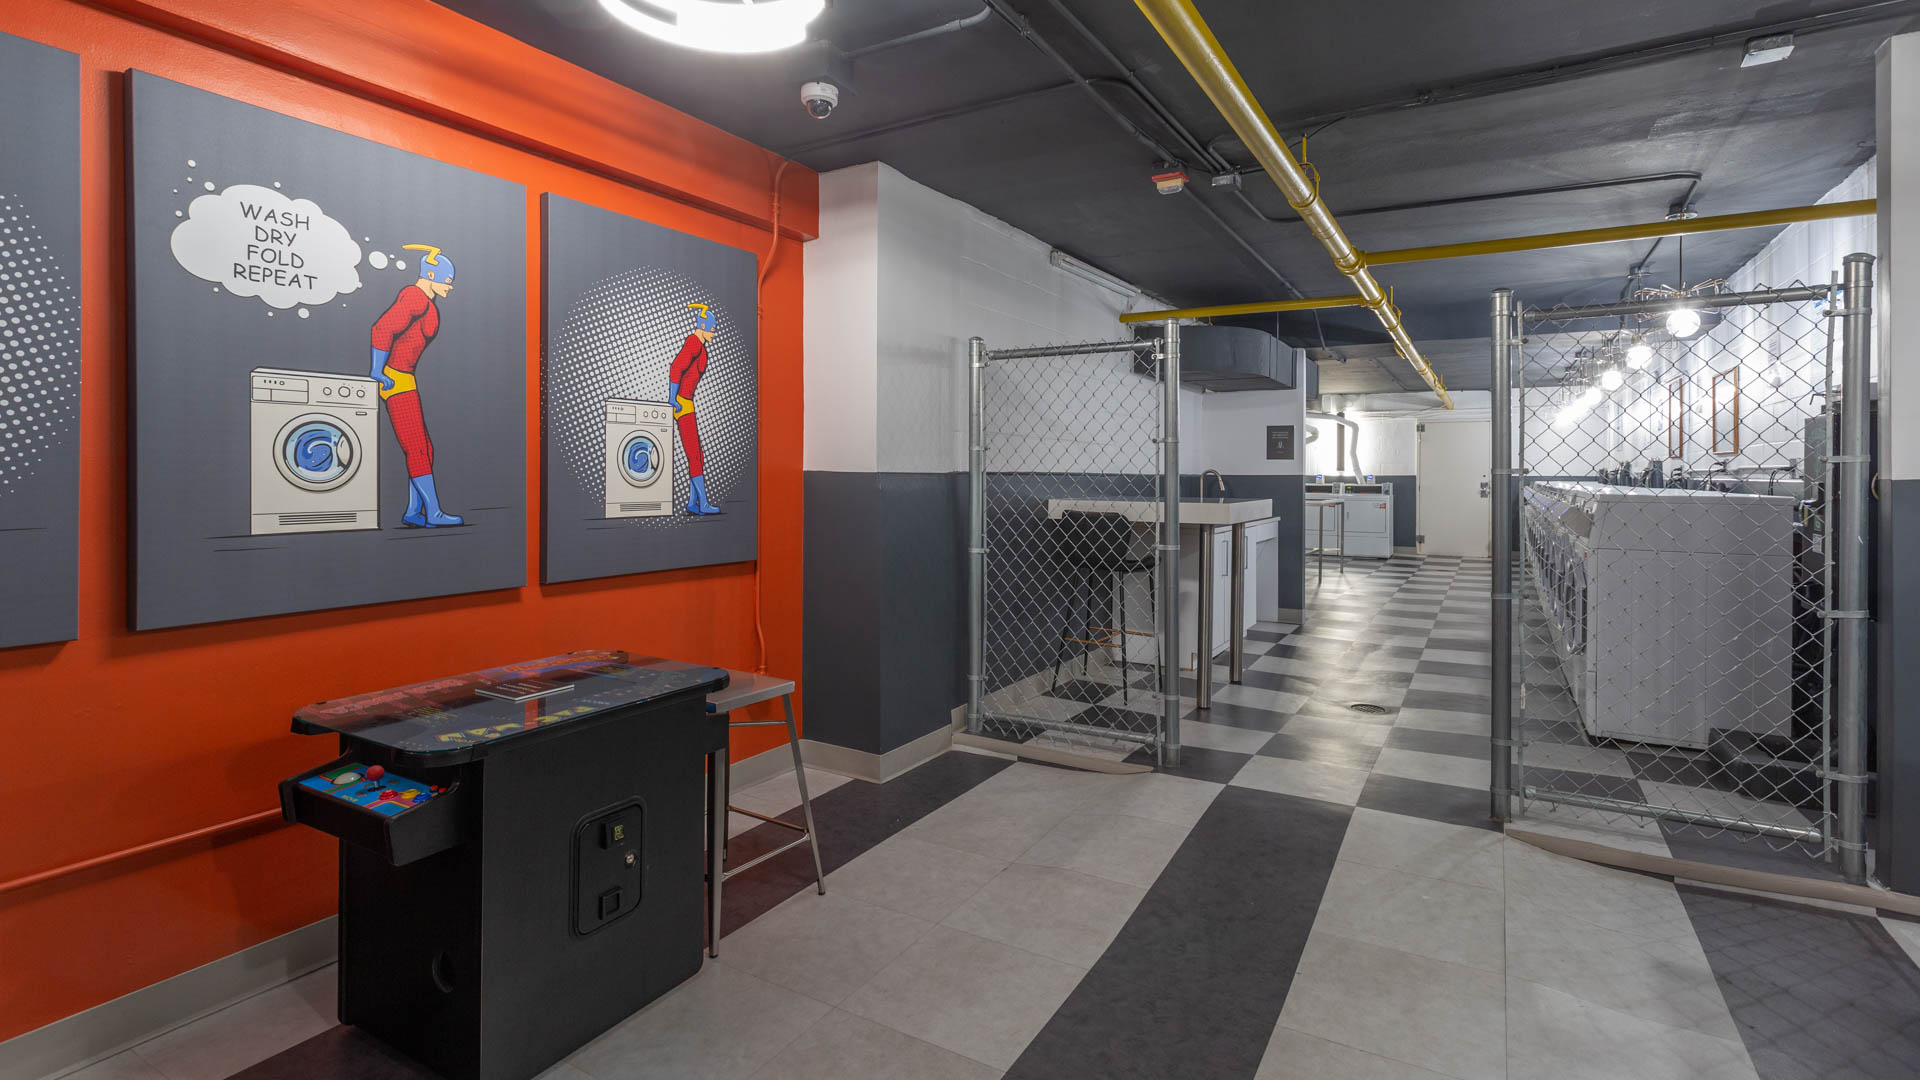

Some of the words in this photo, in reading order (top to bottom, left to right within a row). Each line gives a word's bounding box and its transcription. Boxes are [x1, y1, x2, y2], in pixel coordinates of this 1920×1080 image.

[240, 201, 310, 230] WASH
[255, 225, 297, 247] DRY
[247, 244, 305, 269] FOLD
[233, 262, 318, 290] REPEAT
